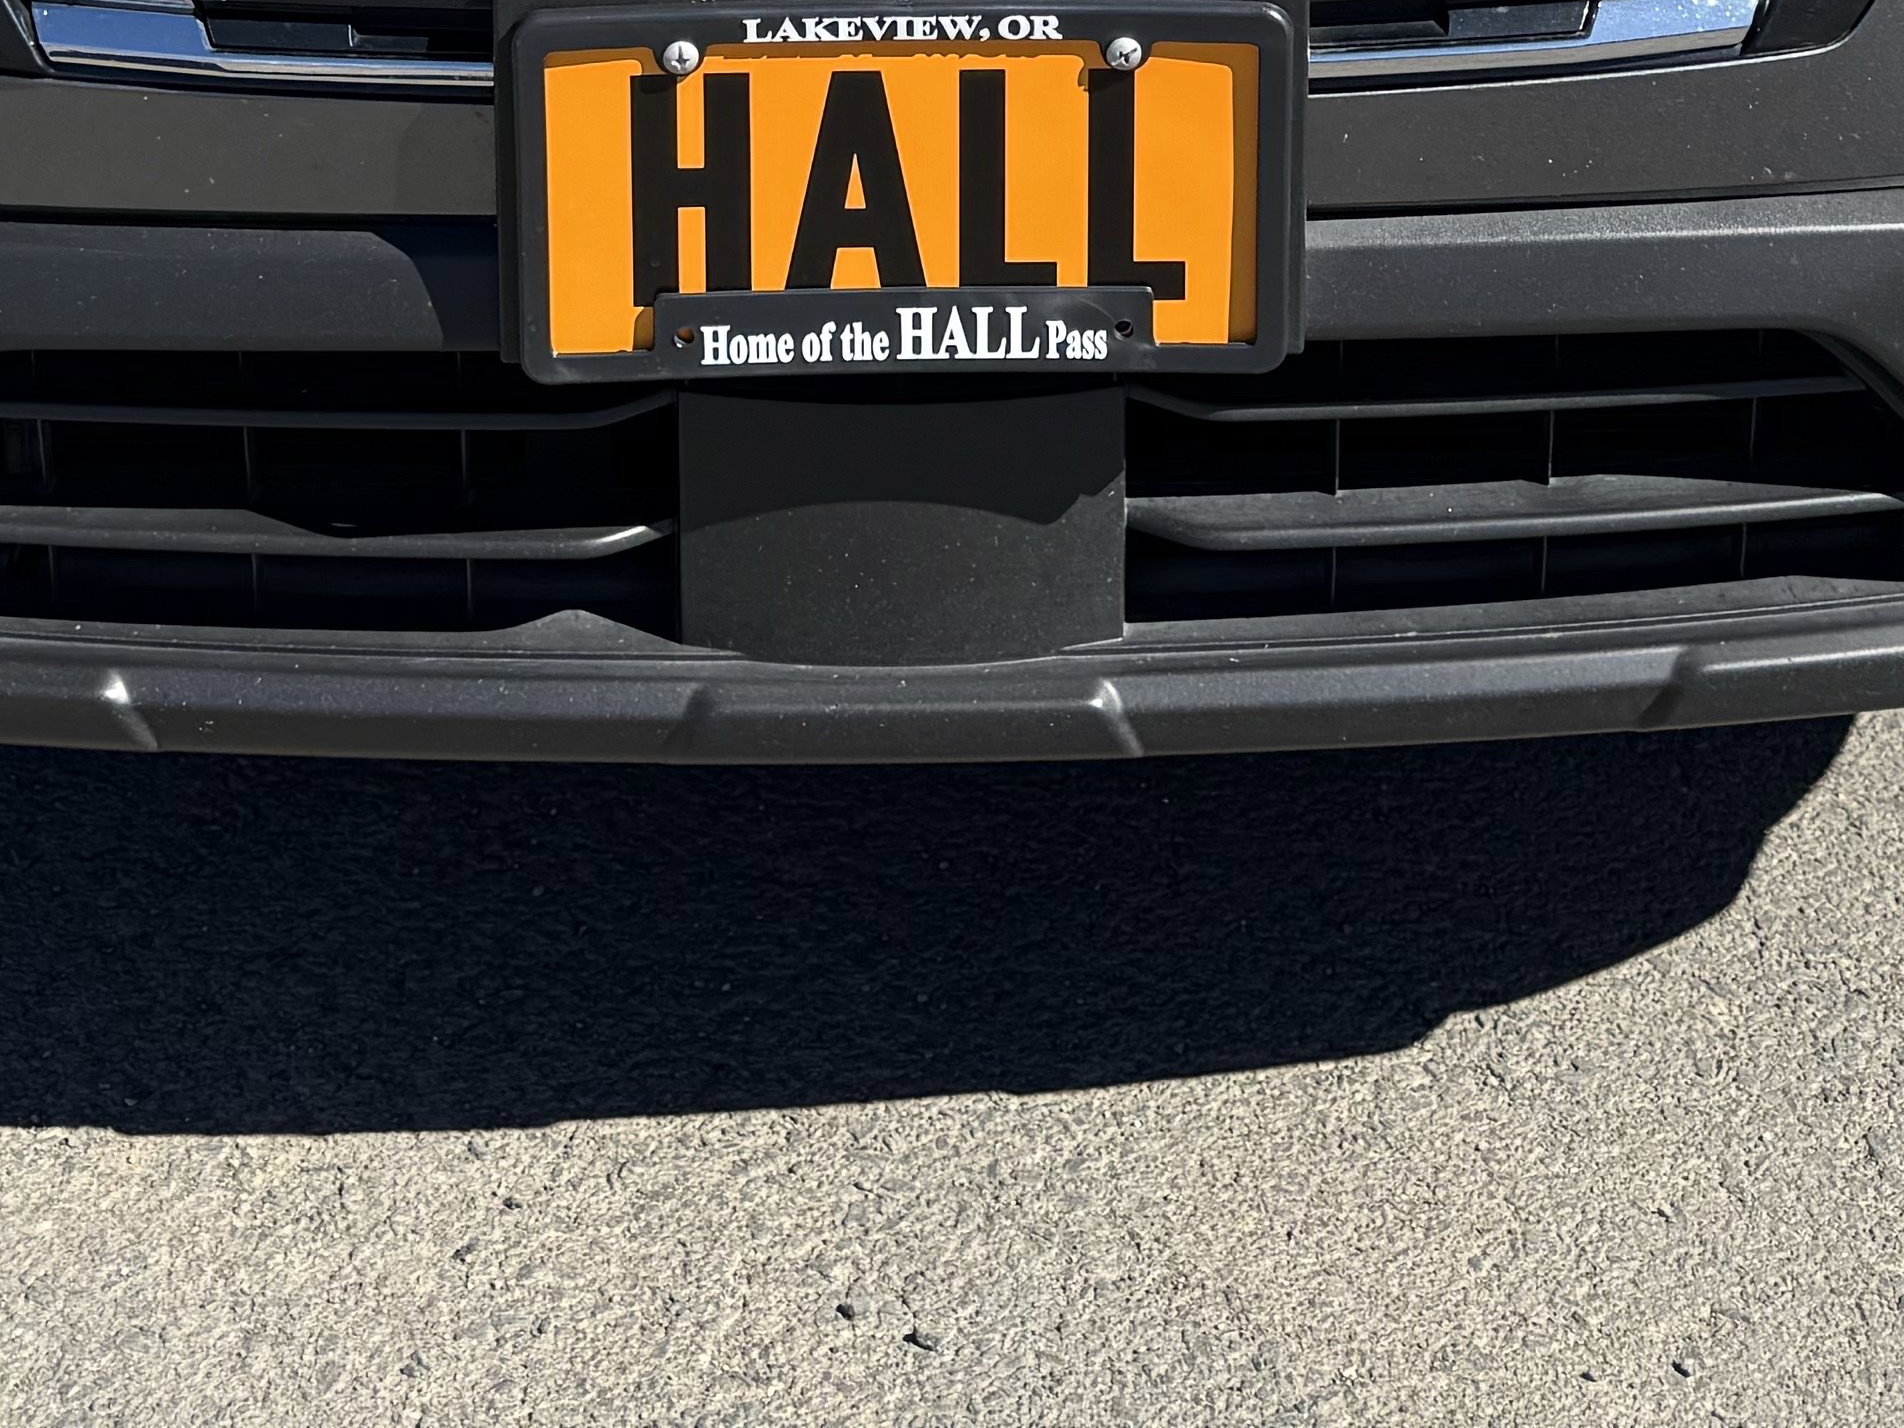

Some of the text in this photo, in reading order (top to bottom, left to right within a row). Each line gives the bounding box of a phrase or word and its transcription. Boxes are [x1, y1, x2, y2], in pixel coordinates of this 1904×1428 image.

[742, 15, 1063, 43] LAKEVIEW, OR
[630, 68, 1186, 307] HALL
[700, 305, 1108, 366] Home of the HALL Pass
